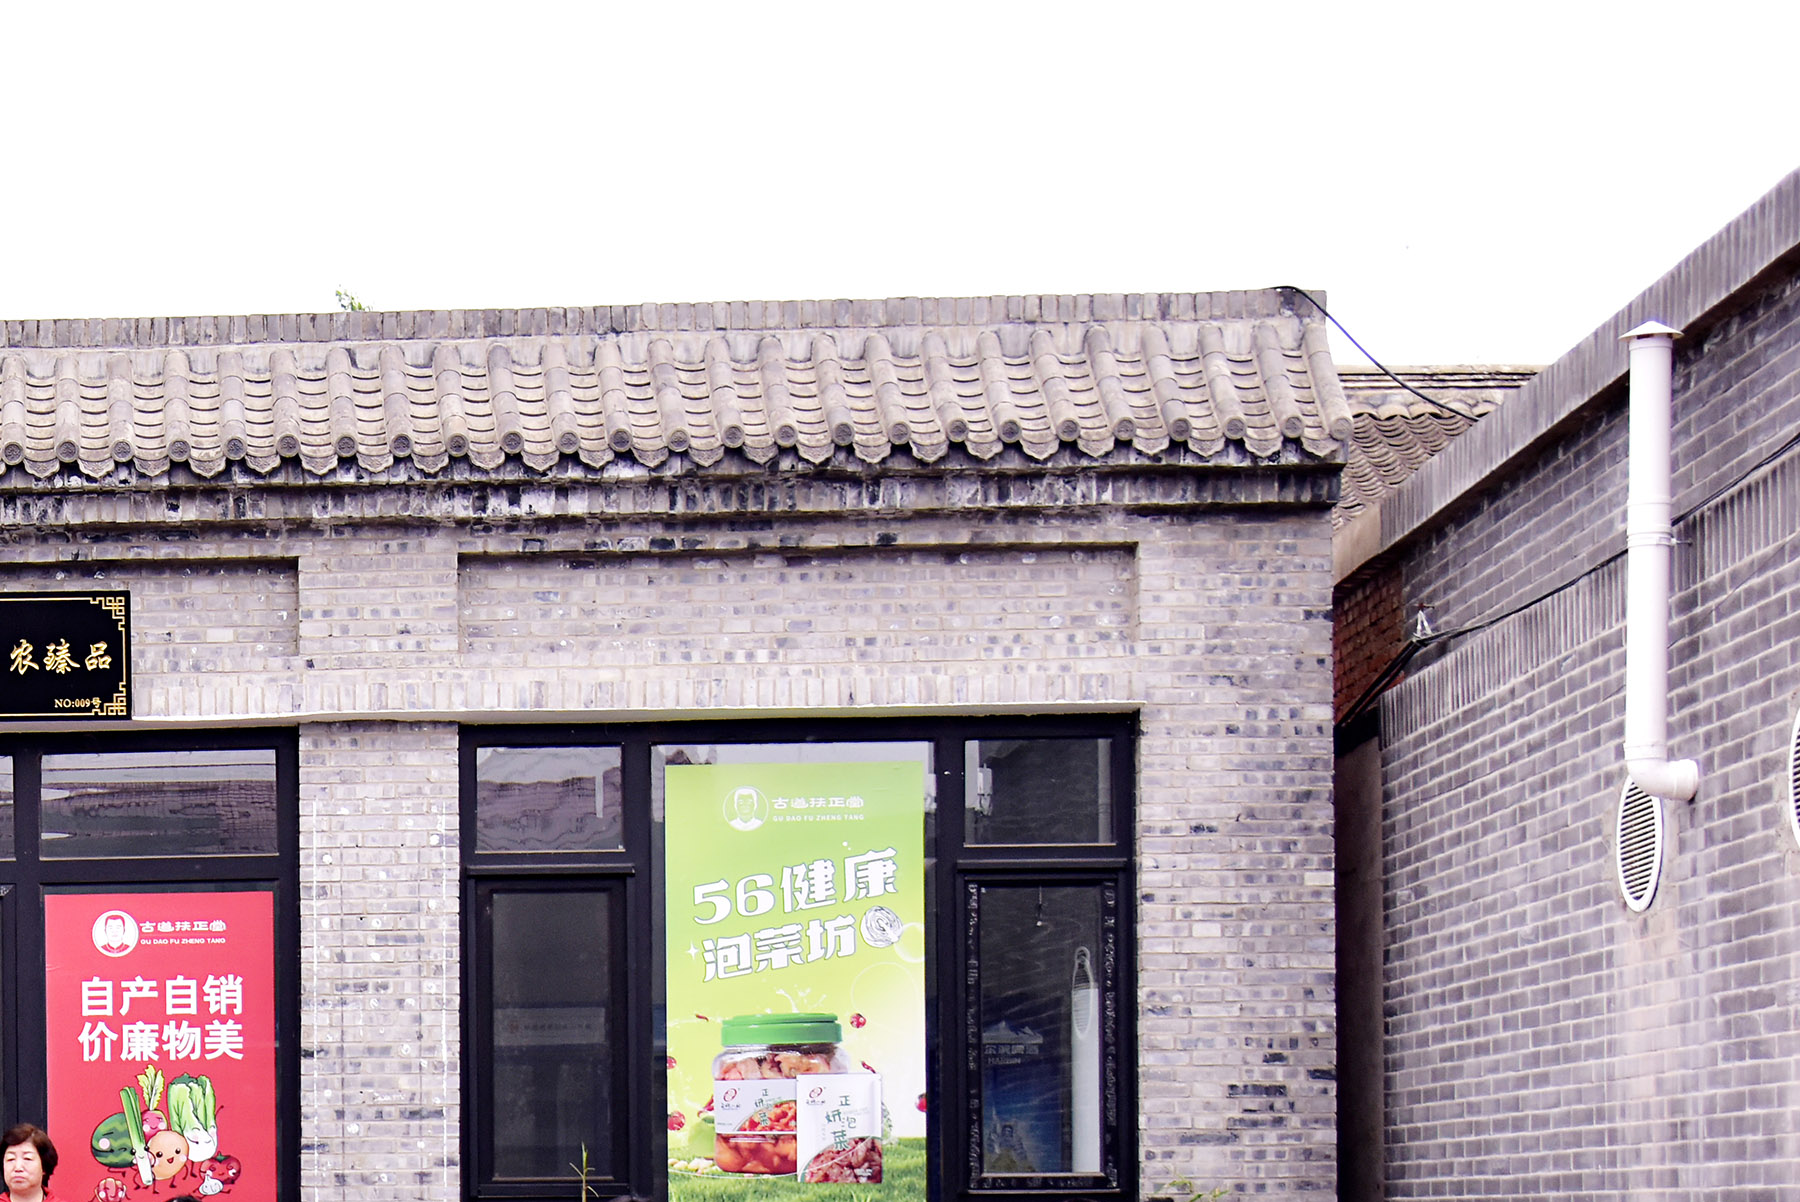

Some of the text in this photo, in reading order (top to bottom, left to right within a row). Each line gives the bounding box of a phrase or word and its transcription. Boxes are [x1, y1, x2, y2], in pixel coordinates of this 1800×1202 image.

[693, 847, 898, 925] 56健康
[702, 914, 857, 983] 泡菜坊
[81, 974, 243, 1017] 自产自销
[77, 1018, 244, 1062] 价廉物美
